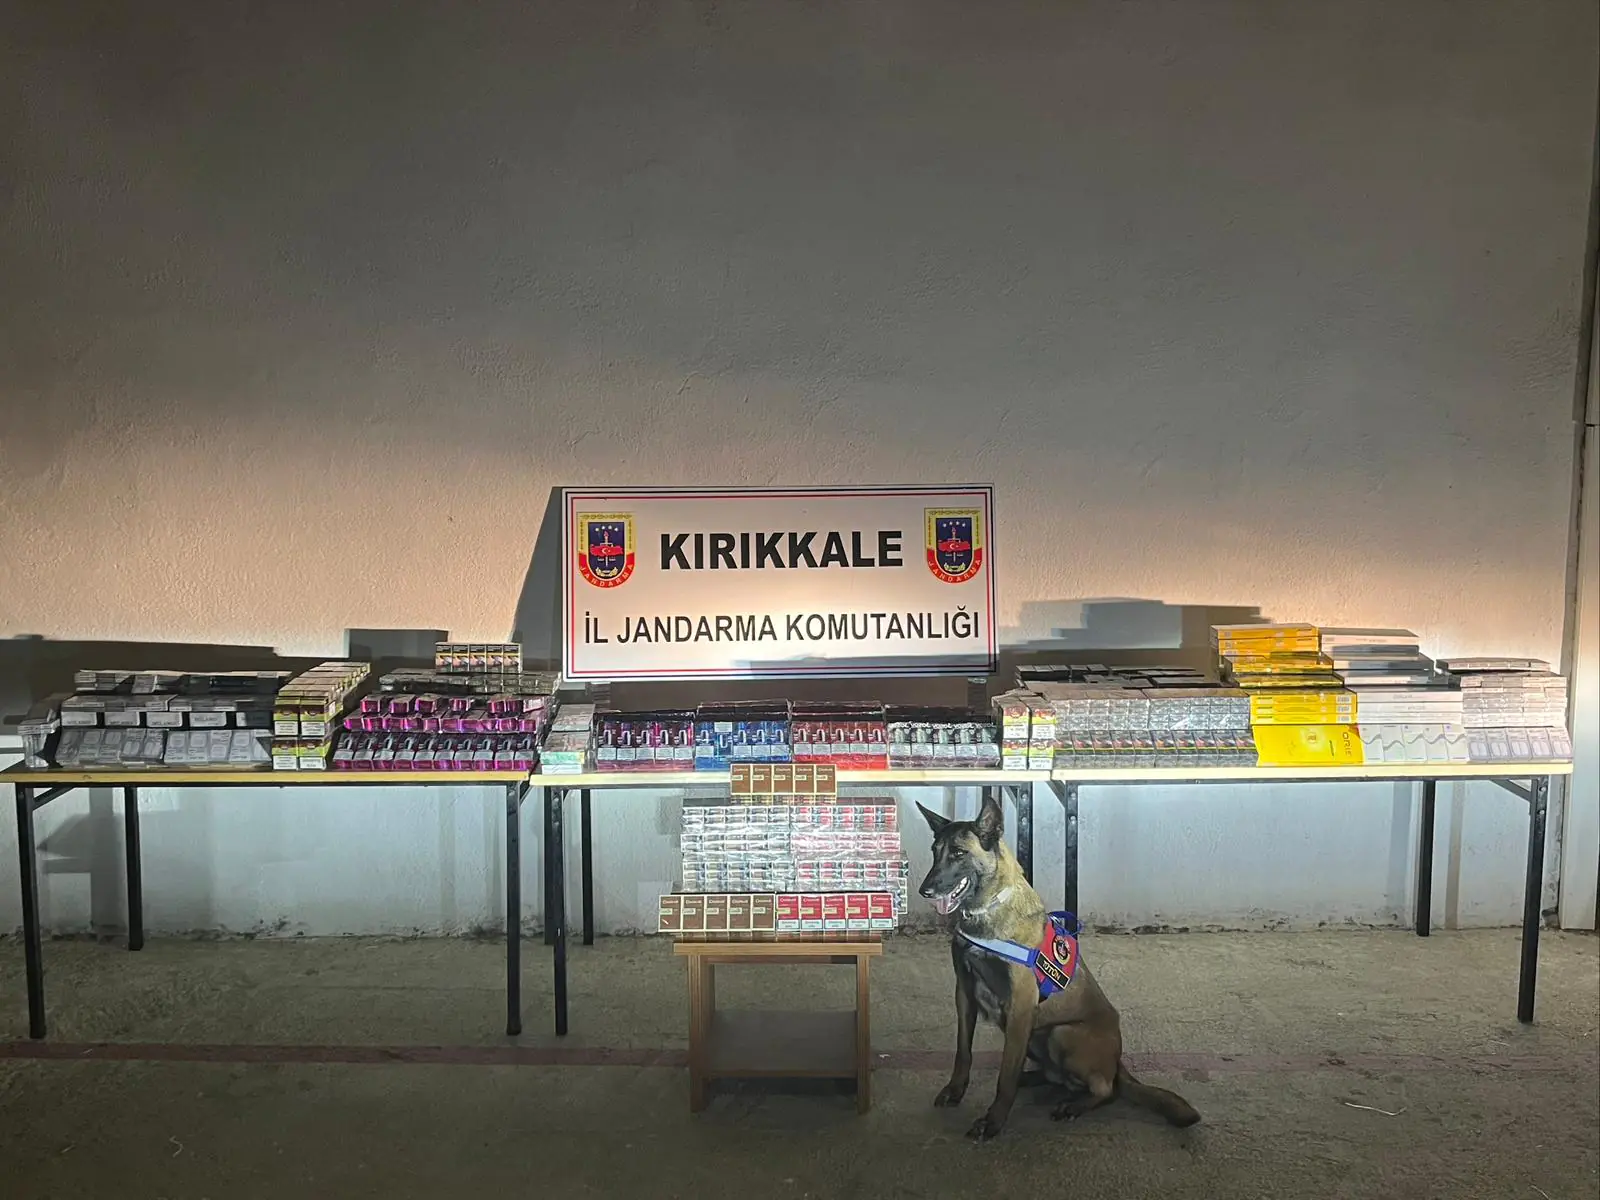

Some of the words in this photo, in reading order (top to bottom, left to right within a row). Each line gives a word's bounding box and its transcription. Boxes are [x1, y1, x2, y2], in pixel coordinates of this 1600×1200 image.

[661, 531, 903, 570] KIRIKKALE
[580, 564, 634, 587] JANDARMA
[928, 560, 981, 583] JANDARMA
[585, 611, 609, 644] İL
[616, 616, 778, 644] JANDARMA
[786, 605, 979, 642] KOMUTANLIĞI
